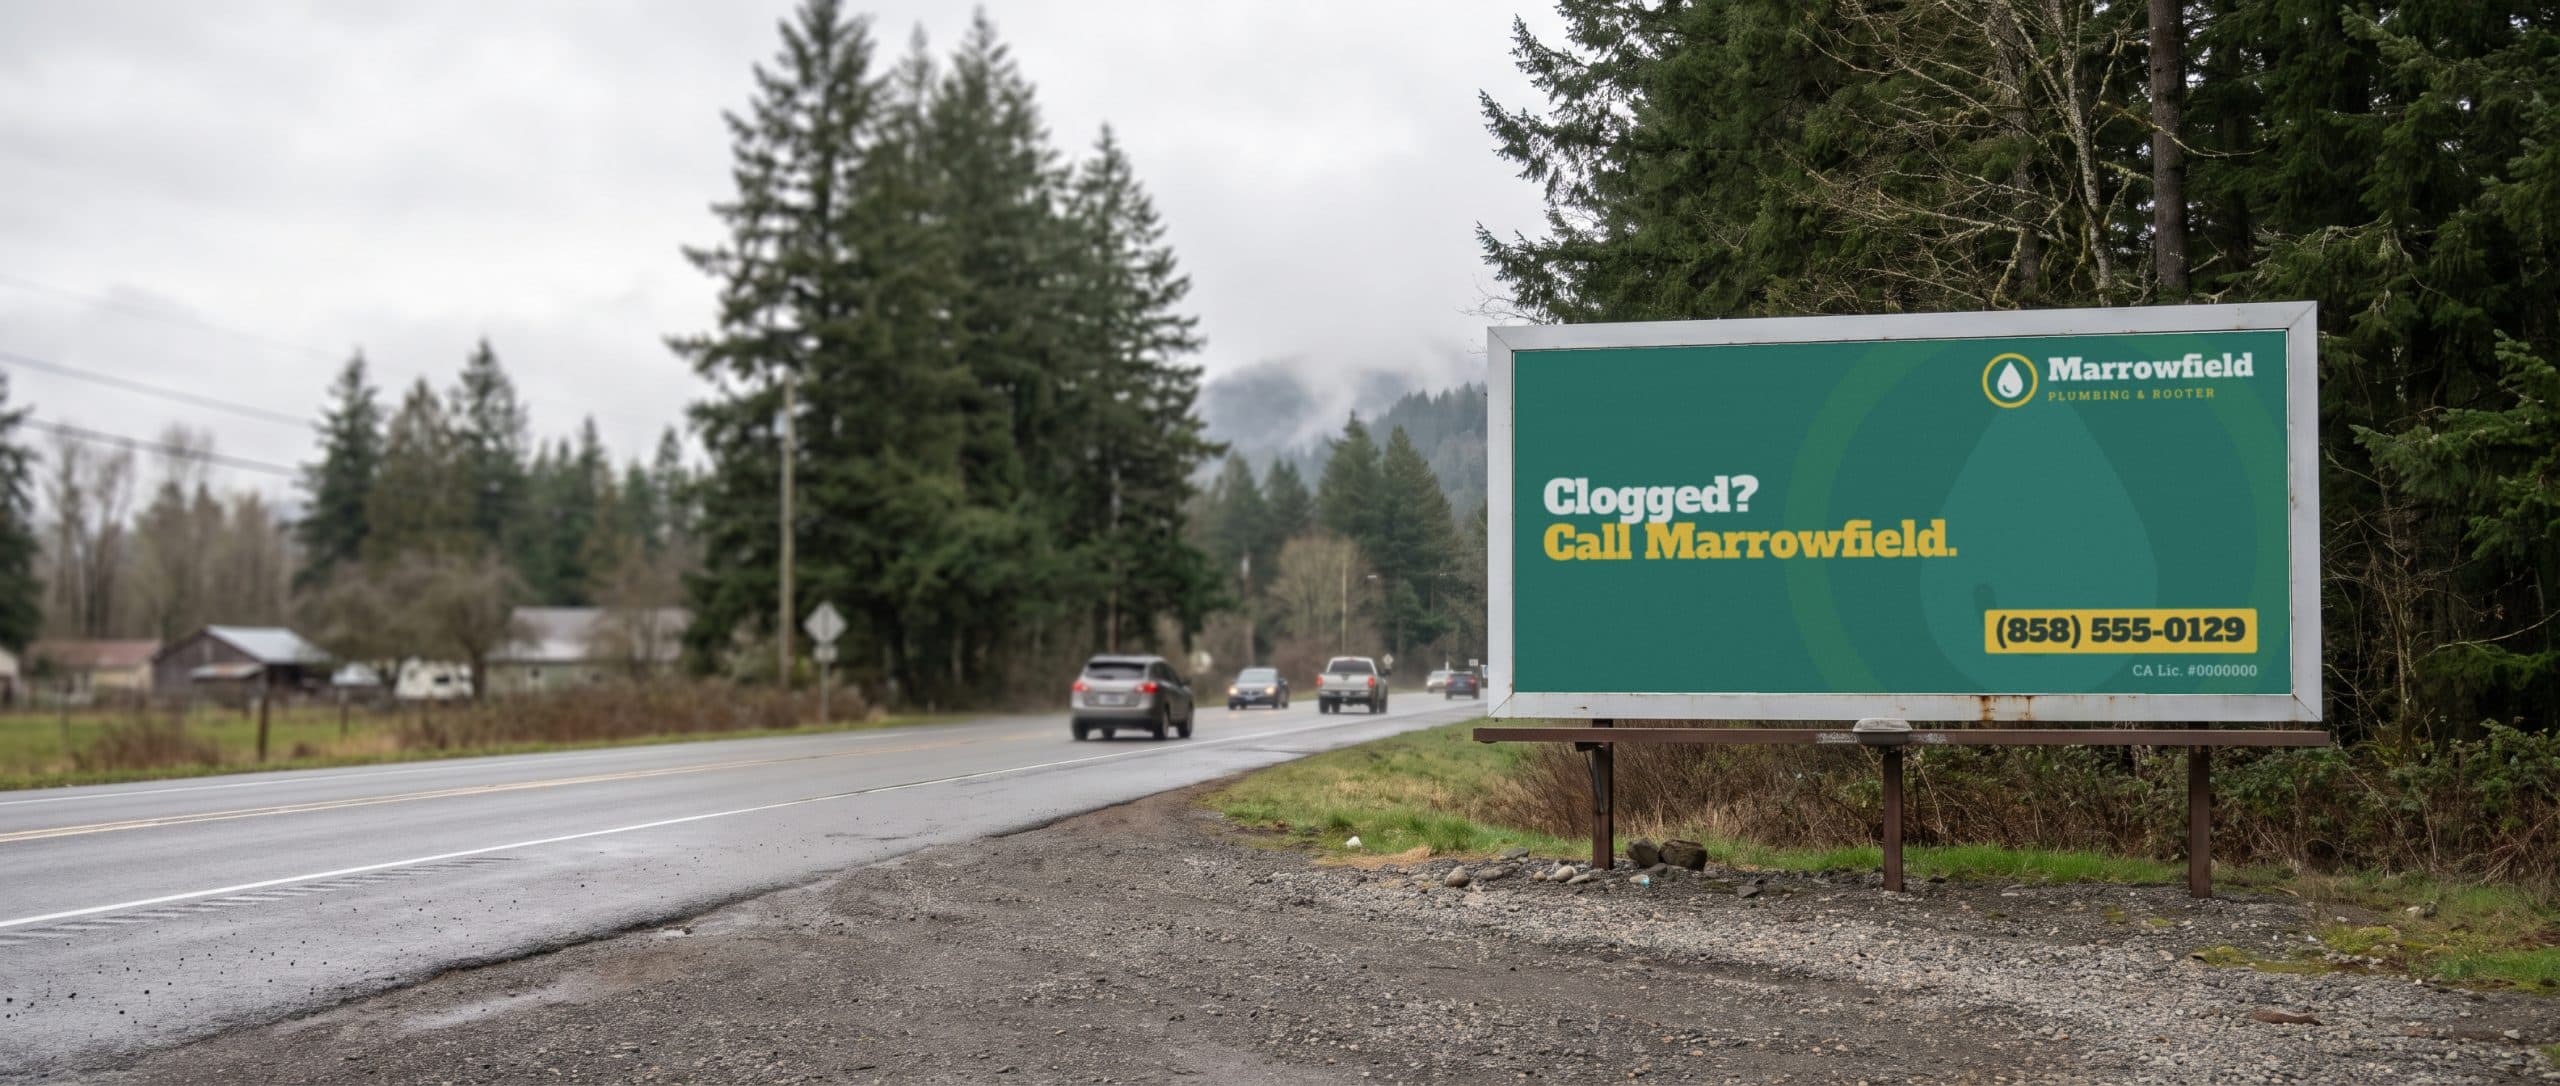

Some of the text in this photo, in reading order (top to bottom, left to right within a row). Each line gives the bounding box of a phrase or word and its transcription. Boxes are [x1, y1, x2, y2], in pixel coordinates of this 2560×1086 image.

[2048, 352, 2254, 382] Marrowfield
[2048, 387, 2216, 402] PLUMBING & ROOTER
[1543, 474, 1760, 525] Clogged?
[1543, 519, 1958, 561] Call Marrowfield.
[1996, 614, 2247, 650] (858) 555-0129
[2132, 664, 2258, 678] CA Lic. #0000000
